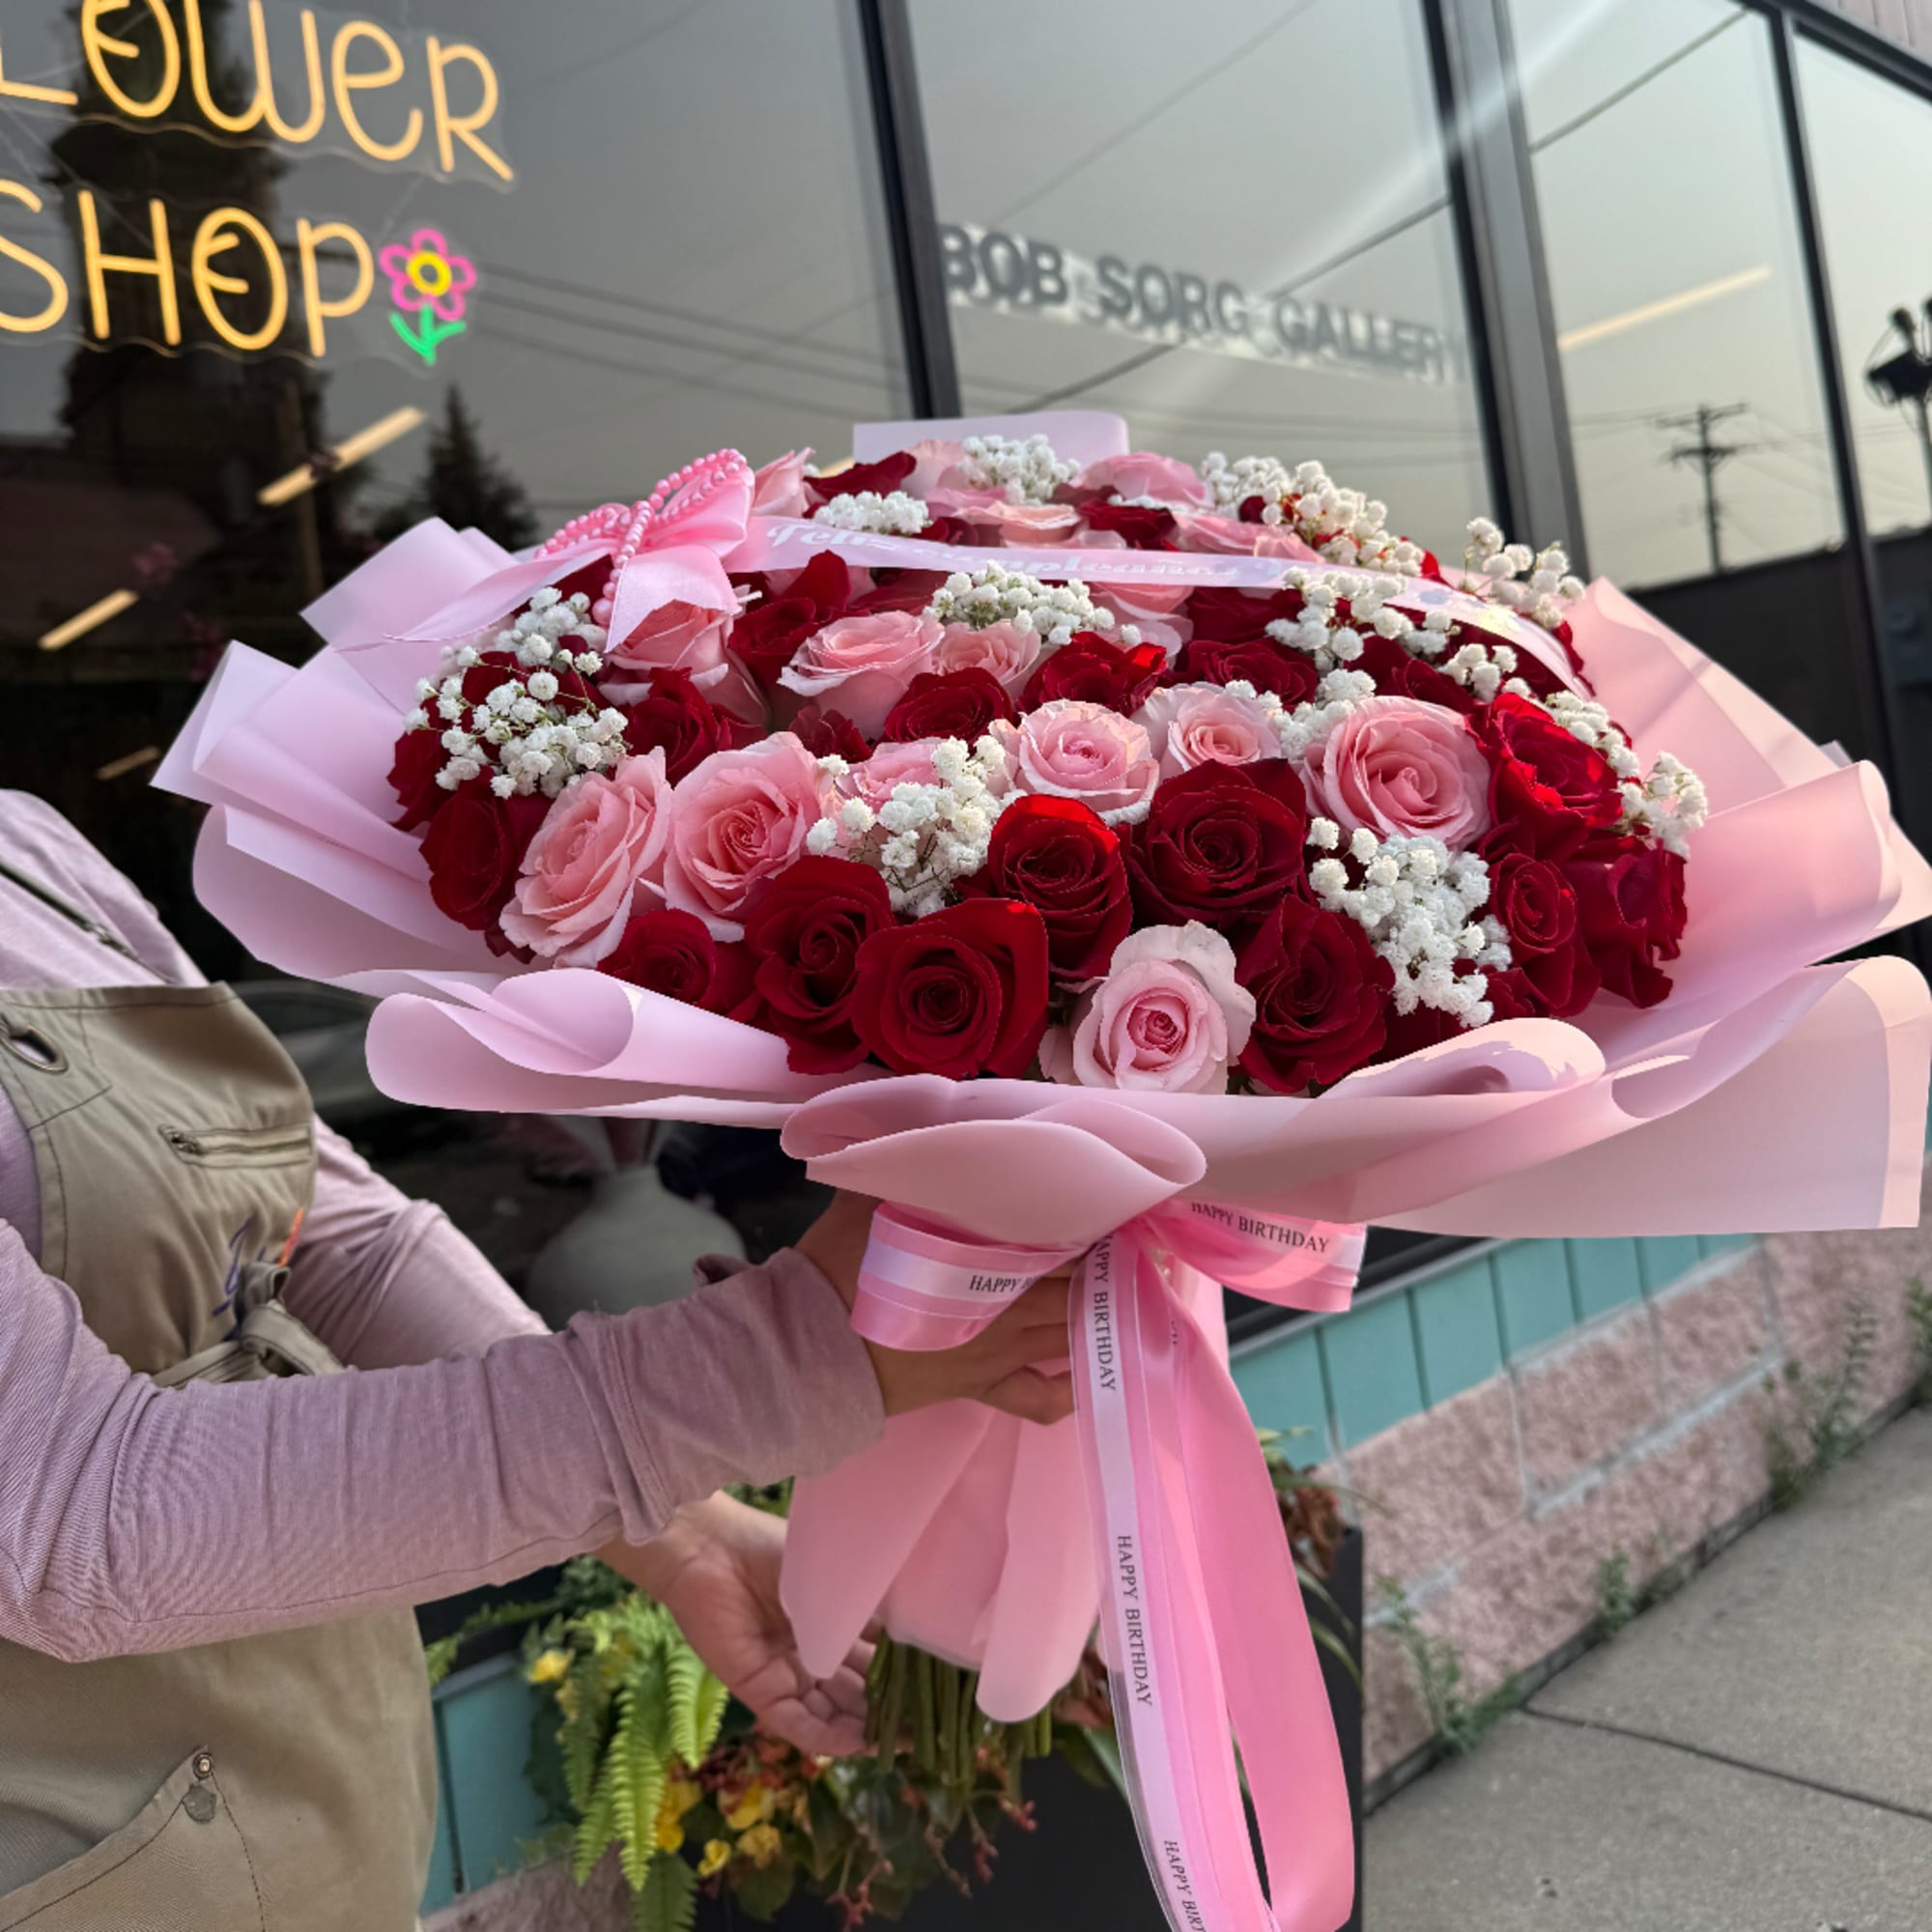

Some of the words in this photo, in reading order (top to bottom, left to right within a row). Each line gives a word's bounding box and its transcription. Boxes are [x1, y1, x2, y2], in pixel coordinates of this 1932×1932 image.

[0, 180, 375, 358] SHOP
[938, 223, 1067, 303] BOB
[1095, 253, 1247, 333] SORG
[1272, 295, 1464, 379] GALLER
[1238, 1215, 1329, 1253] BIRTHDAY
[969, 1274, 1021, 1293] HAPPY
[1094, 1292, 1117, 1390] BIRTHDAY
[1117, 1535, 1139, 1600] HAPPY
[1124, 1608, 1152, 1706] BIRTHDAY
[1164, 1840, 1193, 1894] HAPPY
